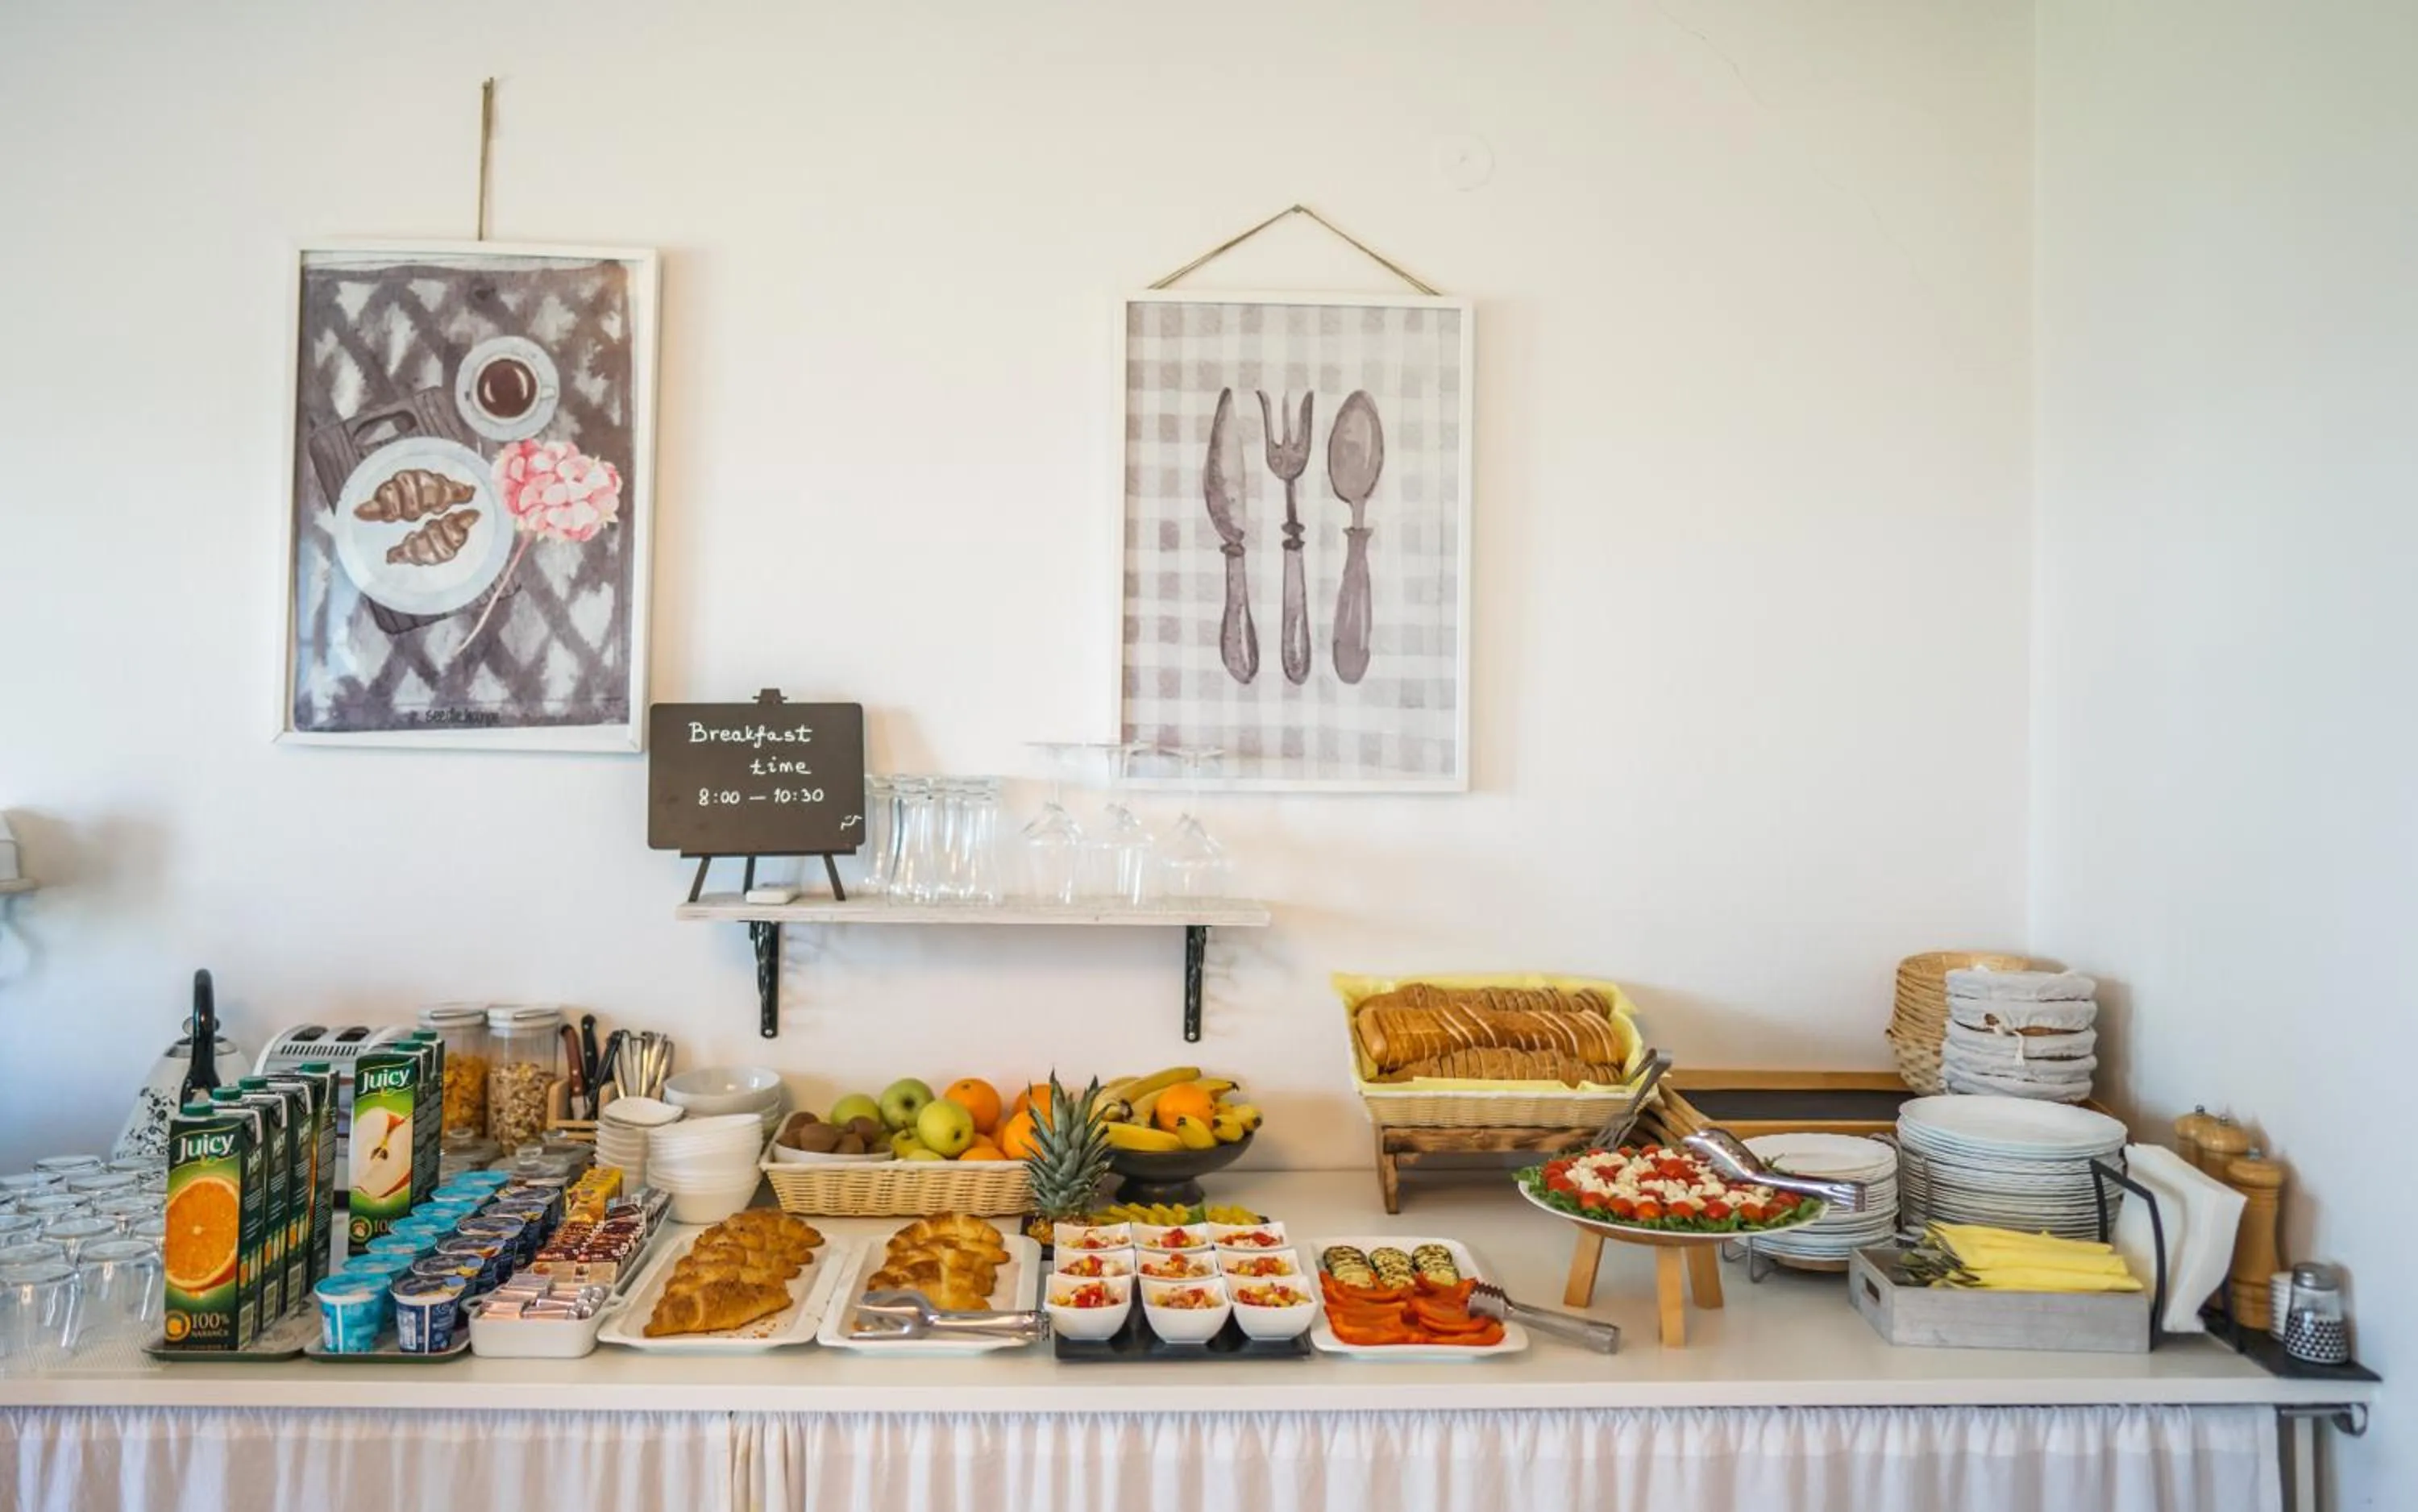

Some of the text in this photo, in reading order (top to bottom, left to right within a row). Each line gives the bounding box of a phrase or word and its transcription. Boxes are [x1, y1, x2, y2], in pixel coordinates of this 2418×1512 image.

[688, 722, 812, 748] Breakfast
[749, 756, 812, 775] time
[699, 787, 740, 806] 8:00
[774, 787, 824, 804] 10:30
[358, 1069, 410, 1095] Juicy
[171, 1134, 235, 1164] Juicy
